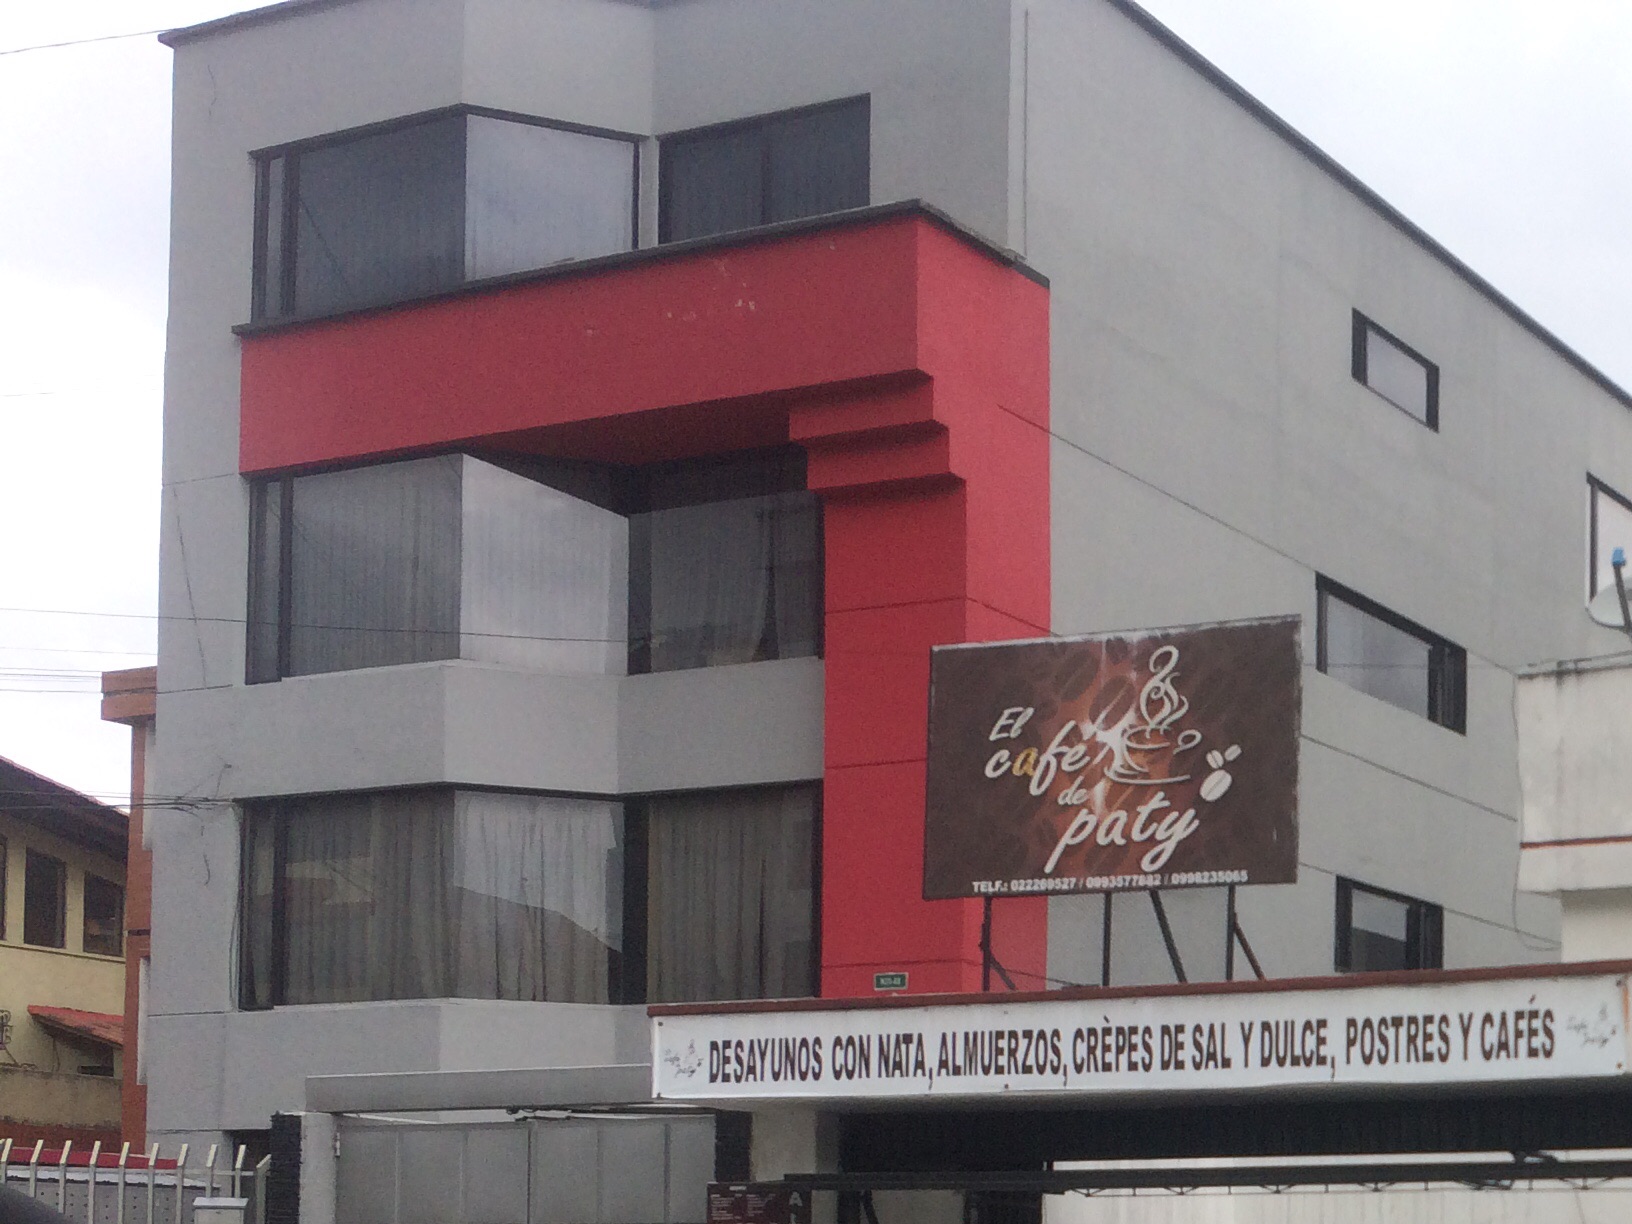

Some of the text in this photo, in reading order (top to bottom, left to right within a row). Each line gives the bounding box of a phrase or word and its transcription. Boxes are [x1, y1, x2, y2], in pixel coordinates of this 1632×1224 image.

[989, 706, 1035, 741] El
[1057, 775, 1088, 805] de
[1044, 791, 1200, 874] paty
[708, 1036, 823, 1084] DESAYUNOS
[831, 1033, 871, 1081] CON
[878, 1032, 933, 1089] NATA,
[937, 1028, 1069, 1087] ALMUERZOS,
[1160, 1024, 1186, 1071] DE
[1192, 1021, 1232, 1070] SAL
[1239, 1020, 1256, 1068] Y
[1260, 1018, 1336, 1081] DULCE,
[1345, 1013, 1450, 1065] POSTRES
[1457, 1012, 1474, 1061] Y
[1480, 995, 1555, 1060] CAFÉS
